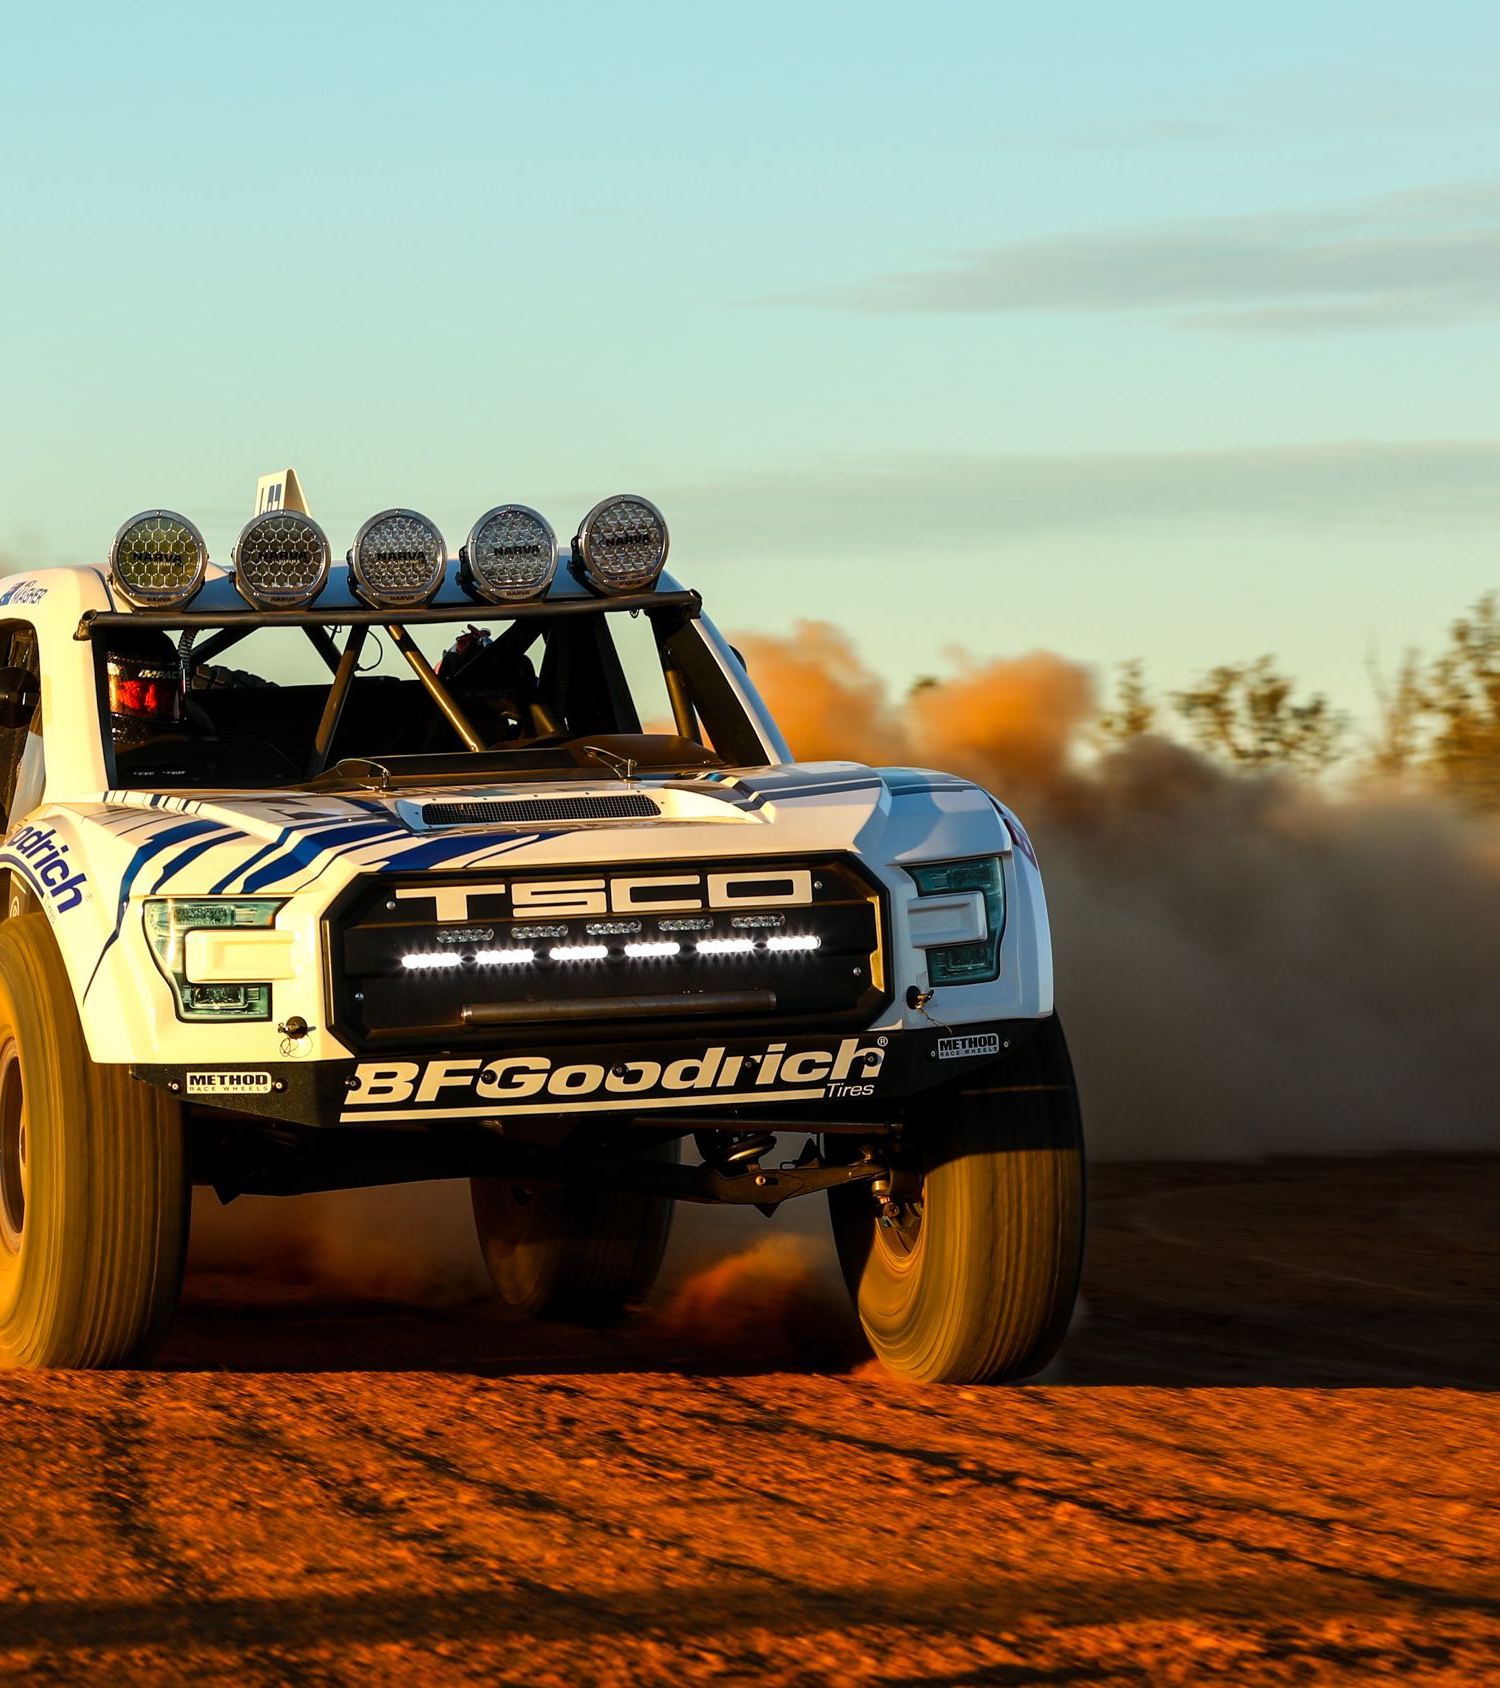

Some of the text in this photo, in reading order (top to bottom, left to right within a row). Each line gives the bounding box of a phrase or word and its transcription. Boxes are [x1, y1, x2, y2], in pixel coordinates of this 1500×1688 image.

[259, 552, 308, 561] NARVA
[377, 552, 427, 561] NARVA
[493, 545, 541, 556] NARVA
[132, 552, 183, 562] NARVA
[6, 826, 87, 914] odrich
[395, 870, 813, 922] TSCO
[940, 1035, 997, 1051] METHOD
[964, 1046, 998, 1055] WHEELS
[344, 1038, 886, 1105] BFGoodrich
[189, 1074, 269, 1086] METHOD
[826, 1082, 875, 1098] Tires
